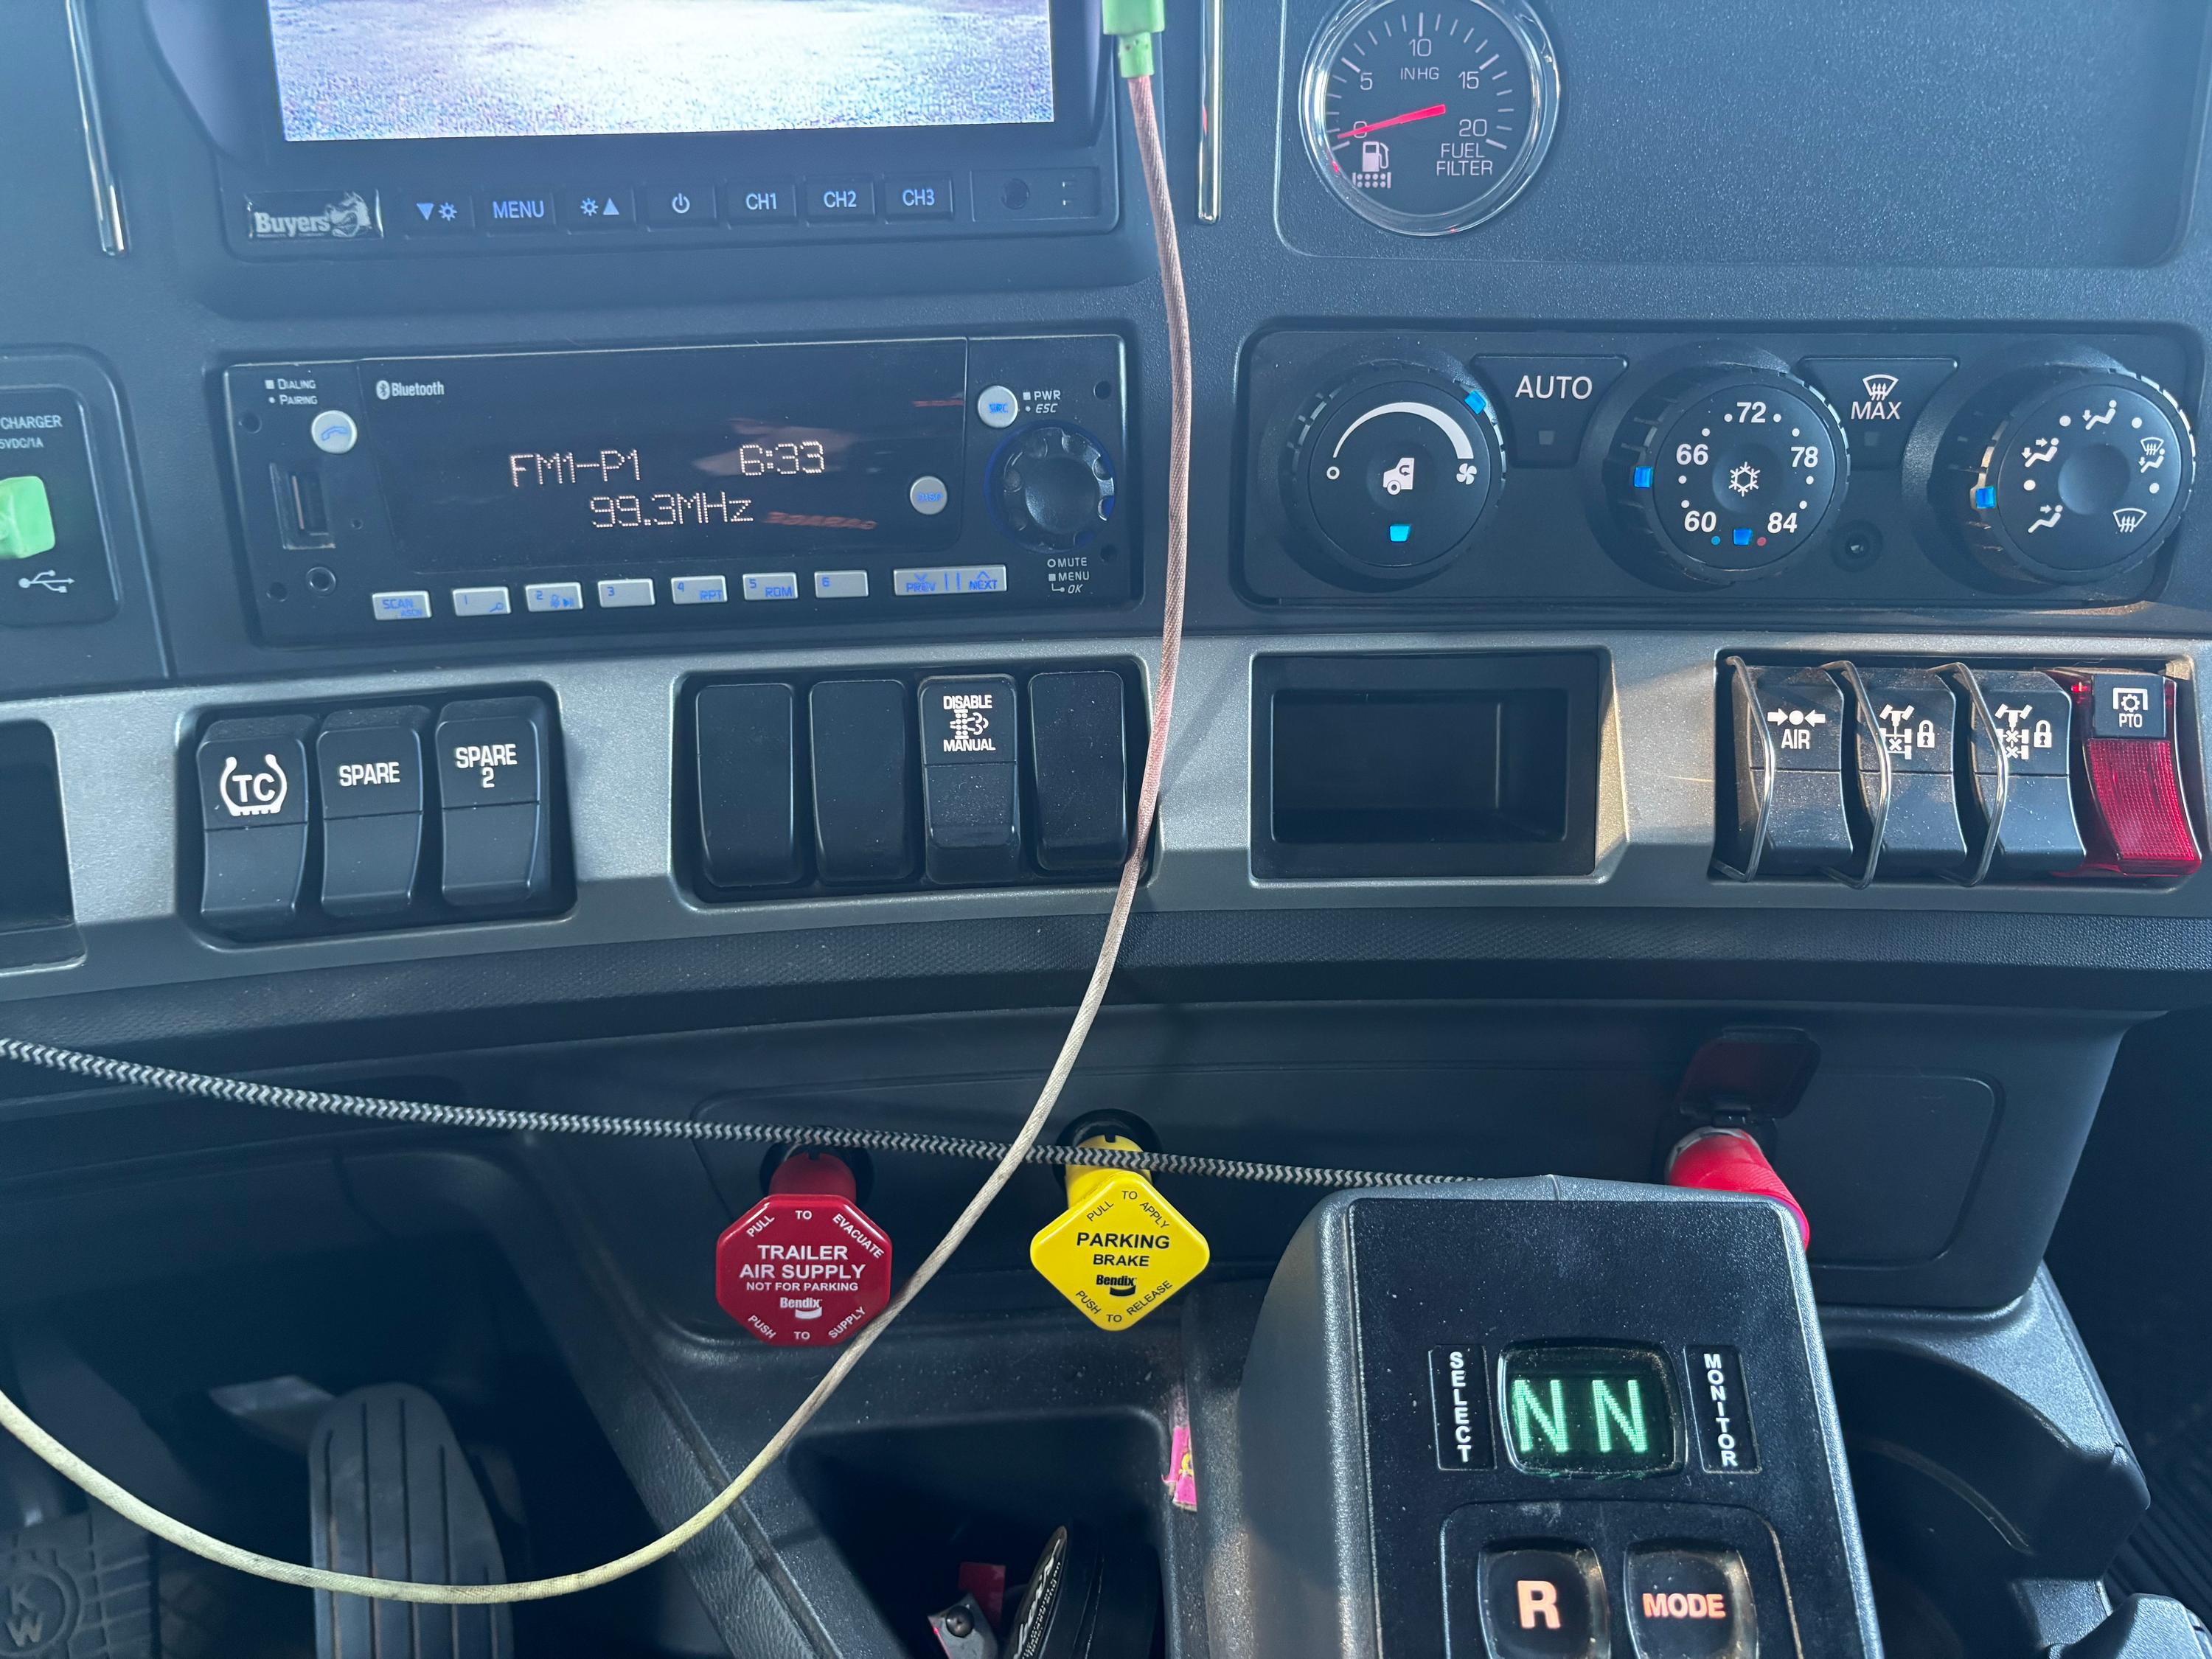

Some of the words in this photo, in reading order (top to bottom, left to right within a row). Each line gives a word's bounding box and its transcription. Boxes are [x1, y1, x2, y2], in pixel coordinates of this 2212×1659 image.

[1409, 38, 1432, 57] 10
[1360, 72, 1373, 90] 5
[1458, 71, 1479, 89] 15
[1353, 121, 1368, 139] 0
[1458, 119, 1487, 137] 20
[1440, 142, 1485, 159] FUEL
[1436, 161, 1493, 176] FILTER
[745, 192, 777, 210] CH1
[823, 190, 858, 209] CH2
[902, 188, 936, 206] CH3
[493, 200, 545, 219] MENU
[254, 212, 331, 237] Buyers
[392, 381, 445, 397] Bluetooth
[1034, 390, 1061, 400] PWR
[1515, 375, 1593, 400] AUTO
[1035, 403, 1058, 414] ESC
[1736, 401, 1767, 424] 72
[1850, 400, 1902, 420] MAX
[0, 414, 63, 430] CHARGER
[1675, 443, 1709, 465] 66
[1791, 446, 1819, 467] 78
[509, 448, 642, 487] FM1-P1
[739, 440, 826, 476] 6:33
[591, 490, 754, 529] 99.3MHz
[1683, 511, 1717, 533] 60
[1767, 512, 1798, 534] 84
[1057, 557, 1088, 568] MUTE
[748, 579, 757, 589] 5
[821, 577, 830, 588] 6
[969, 579, 998, 591] NEXT
[1058, 571, 1090, 582] MENU
[535, 591, 544, 600] 2
[607, 587, 616, 597] 3
[677, 582, 686, 593] 4
[700, 590, 723, 601] RPT
[905, 581, 937, 592] PREV
[1068, 585, 1082, 594] OK
[382, 598, 414, 609] SCAN
[943, 695, 993, 709] DISABLE
[2118, 713, 2143, 728] PTO
[943, 738, 996, 752] MANUAL
[1781, 728, 1811, 750] AIR
[455, 743, 518, 769] SPARE
[338, 762, 400, 787] SPARE
[480, 768, 495, 788] 2
[232, 773, 276, 802] TC
[1086, 1201, 1114, 1222] PULL
[1121, 1191, 1138, 1200] TO
[1139, 1202, 1170, 1230] APPLY
[745, 1215, 775, 1237] PULL
[795, 1210, 813, 1220] TO
[832, 1213, 885, 1259] EVACUATE
[1077, 1232, 1170, 1249] PARKING
[757, 1245, 849, 1260] TRAILER
[1093, 1254, 1150, 1267] BRAKE
[740, 1264, 776, 1279] AIR
[782, 1264, 866, 1279] SUPPLY
[1096, 1274, 1135, 1287] Bendix
[746, 1282, 772, 1291] NOT
[775, 1282, 800, 1291] FOR
[803, 1281, 859, 1291] PARKING
[779, 1297, 821, 1309] Bendix
[1075, 1290, 1102, 1314] PUSH
[1106, 1315, 1122, 1323] TO
[1126, 1280, 1173, 1315] RELEASE
[747, 1315, 776, 1339] PUSH
[793, 1331, 810, 1340] TO
[827, 1306, 866, 1339] SUPPLY
[1449, 1352, 1471, 1463] SELECT
[1512, 1379, 1569, 1453] N
[1591, 1379, 1648, 1453] N
[1703, 1353, 1739, 1467] MONITOR
[1517, 1579, 1561, 1630] R
[1642, 1593, 1726, 1619] MODE
